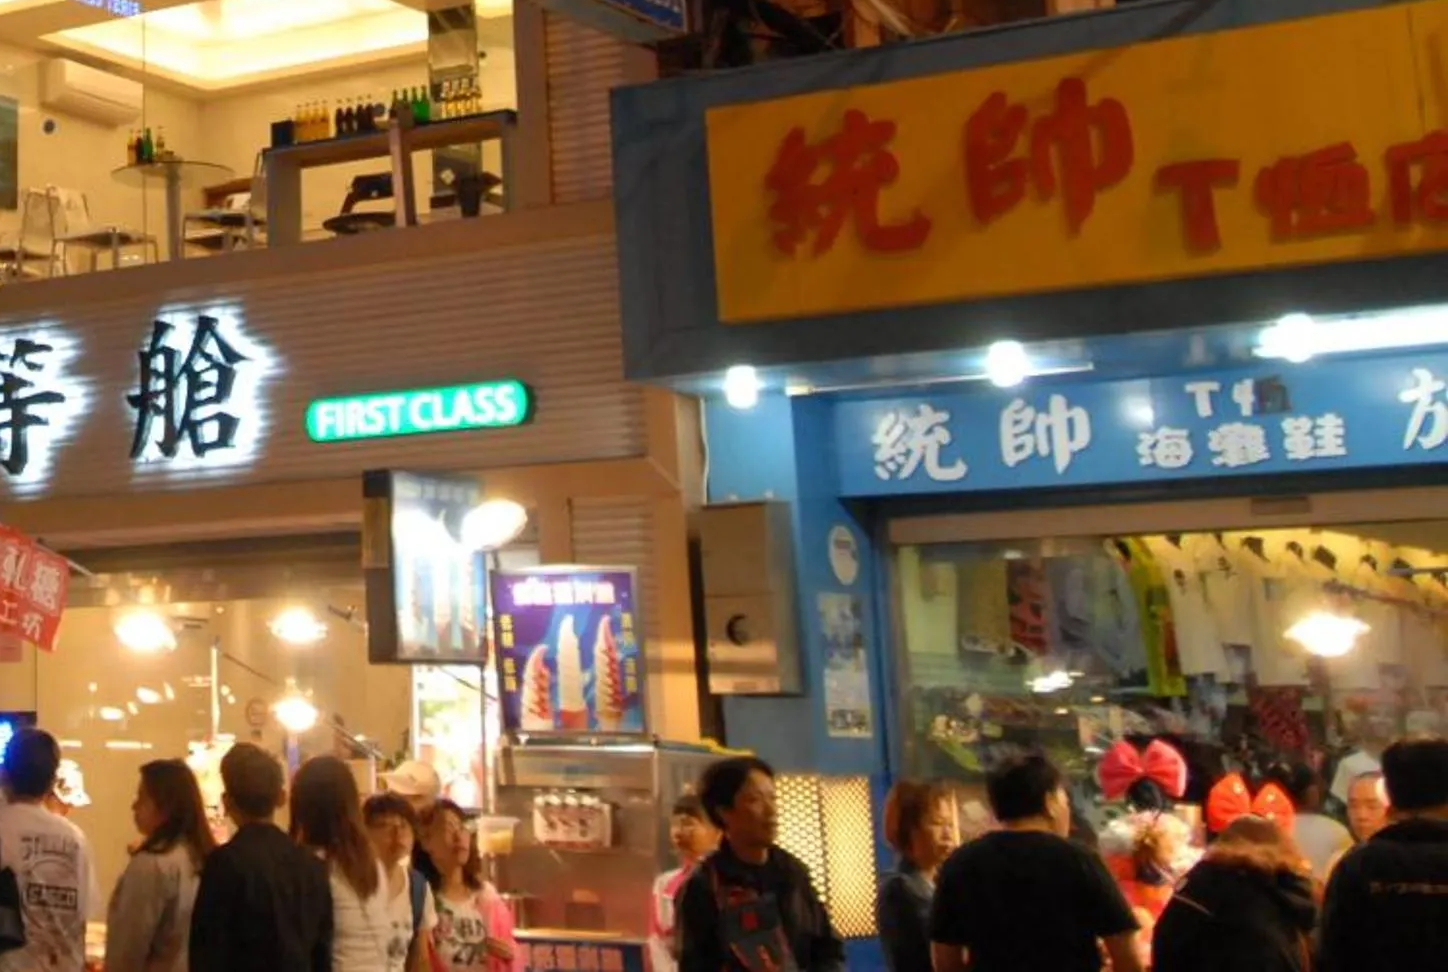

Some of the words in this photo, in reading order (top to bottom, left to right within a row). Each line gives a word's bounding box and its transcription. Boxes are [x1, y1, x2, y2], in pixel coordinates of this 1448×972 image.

[316, 396, 397, 440] FIRST
[409, 384, 518, 432] CLASS
[871, 394, 1092, 482] 統帥
[1136, 412, 1348, 468] 海灘鞋
